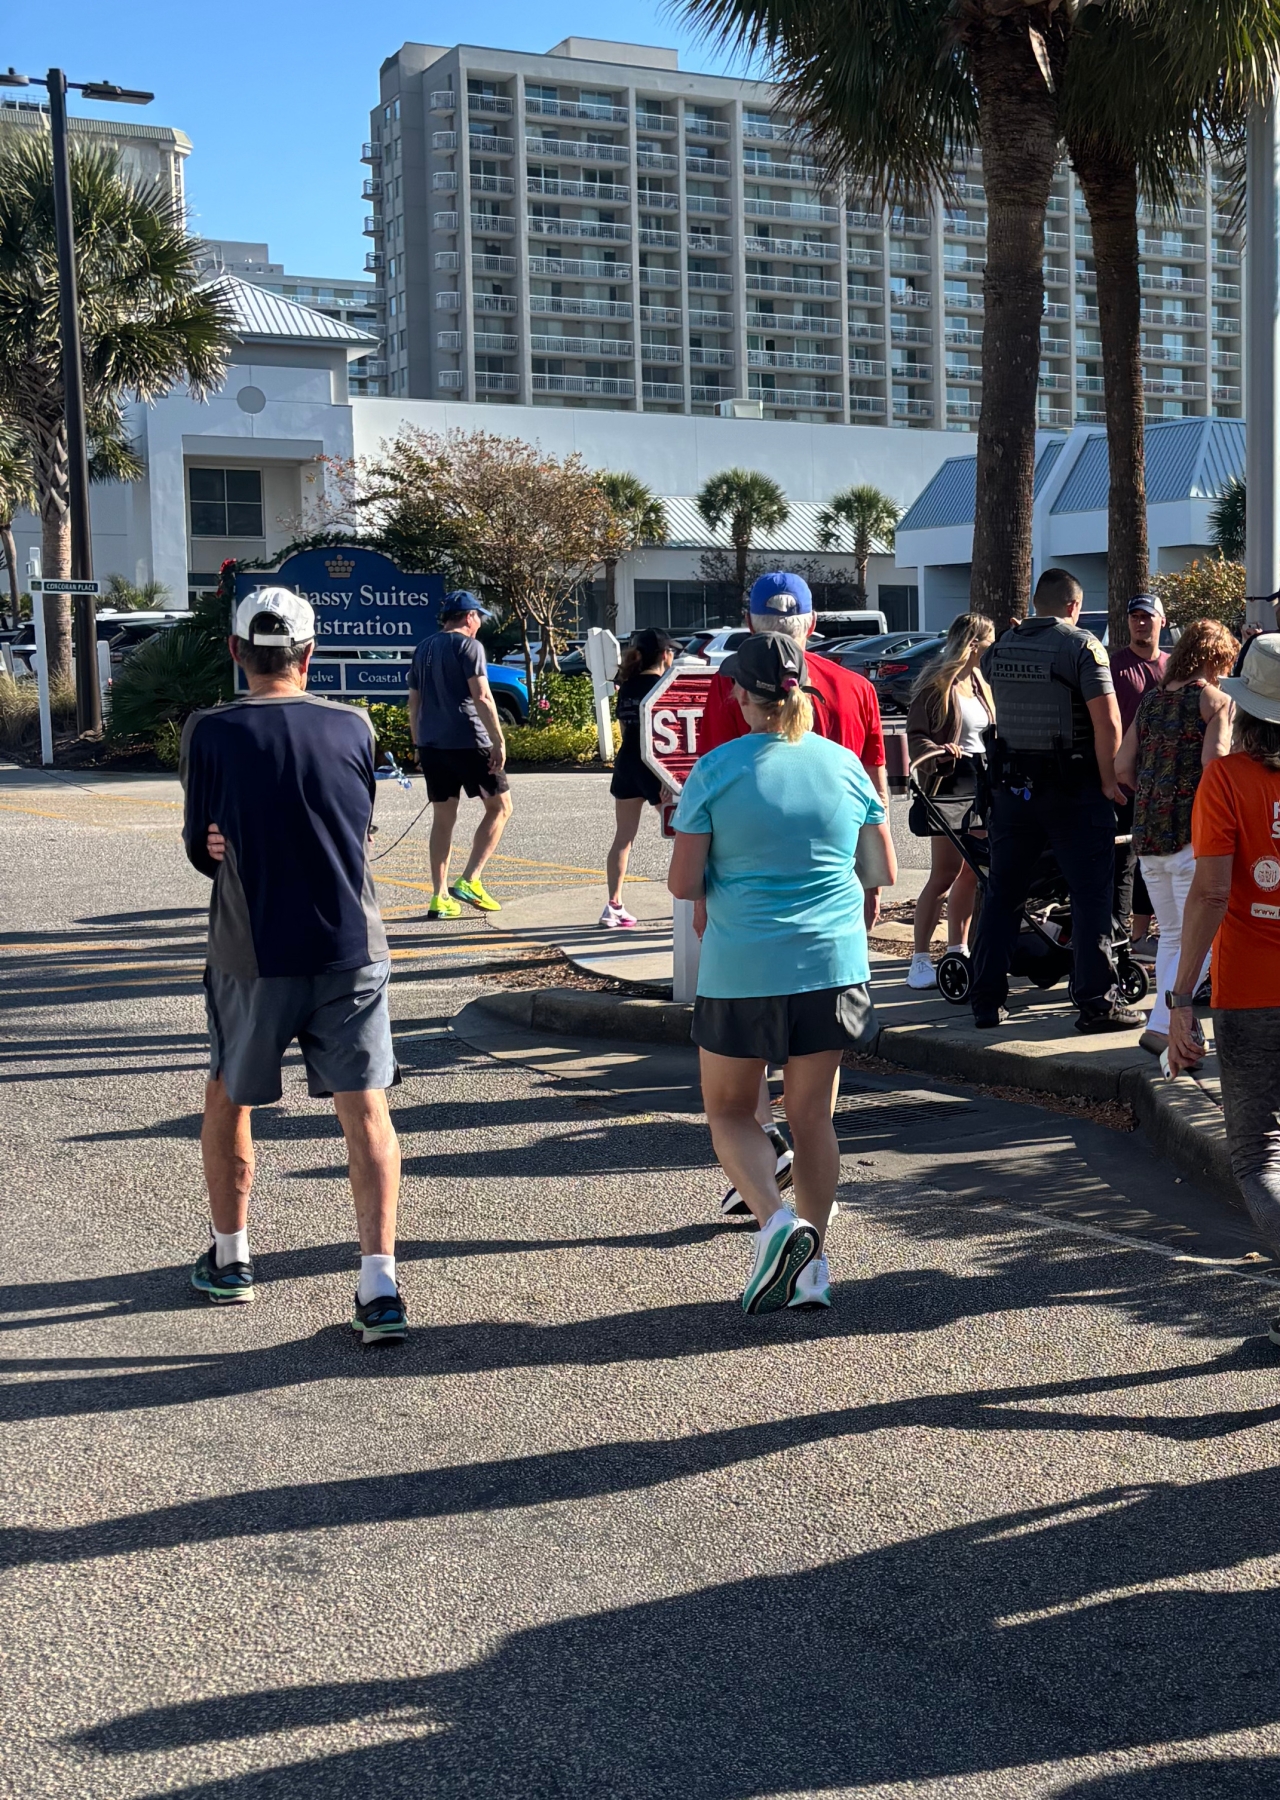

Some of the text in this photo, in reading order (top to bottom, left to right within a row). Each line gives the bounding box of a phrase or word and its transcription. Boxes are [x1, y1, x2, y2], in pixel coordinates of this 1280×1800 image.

[253, 584, 429, 610] bassy Suites
[316, 615, 413, 636] istration
[308, 670, 334, 683] elve
[996, 663, 1043, 673] POLICE
[358, 671, 402, 683] Coastal
[653, 709, 704, 754] ST
